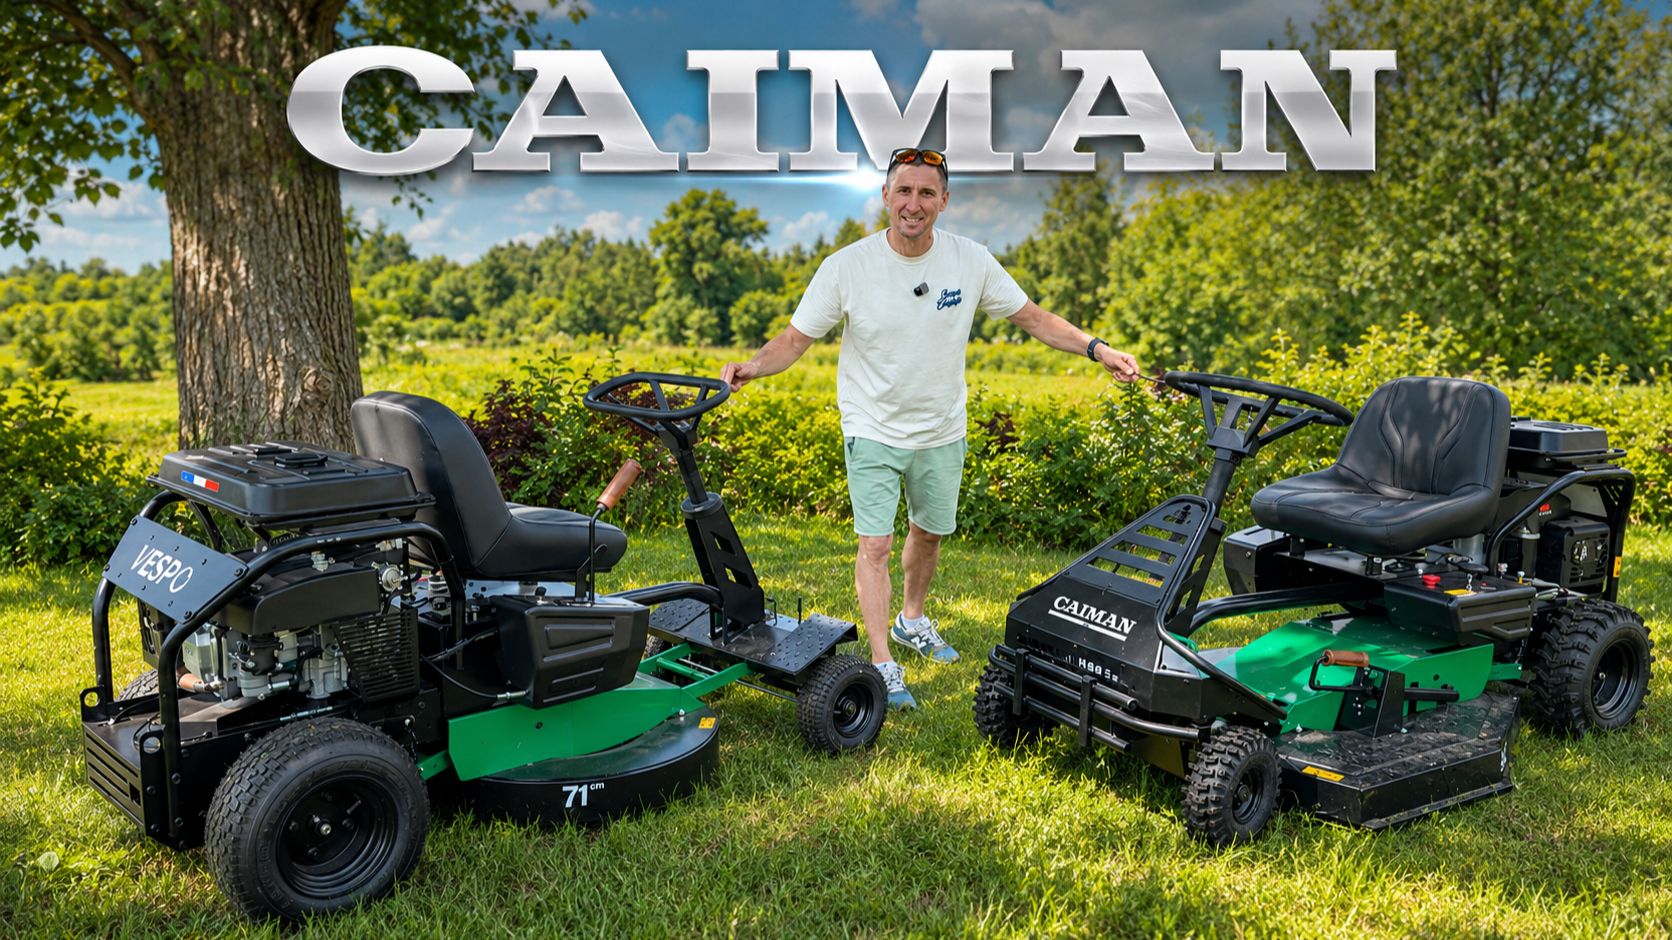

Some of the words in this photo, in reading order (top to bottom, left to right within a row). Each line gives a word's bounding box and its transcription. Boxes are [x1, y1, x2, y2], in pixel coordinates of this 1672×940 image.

[130, 544, 193, 593] VESPO
[1053, 596, 1137, 634] CAIMAN
[562, 784, 588, 808] 71
[590, 782, 605, 791] cm
